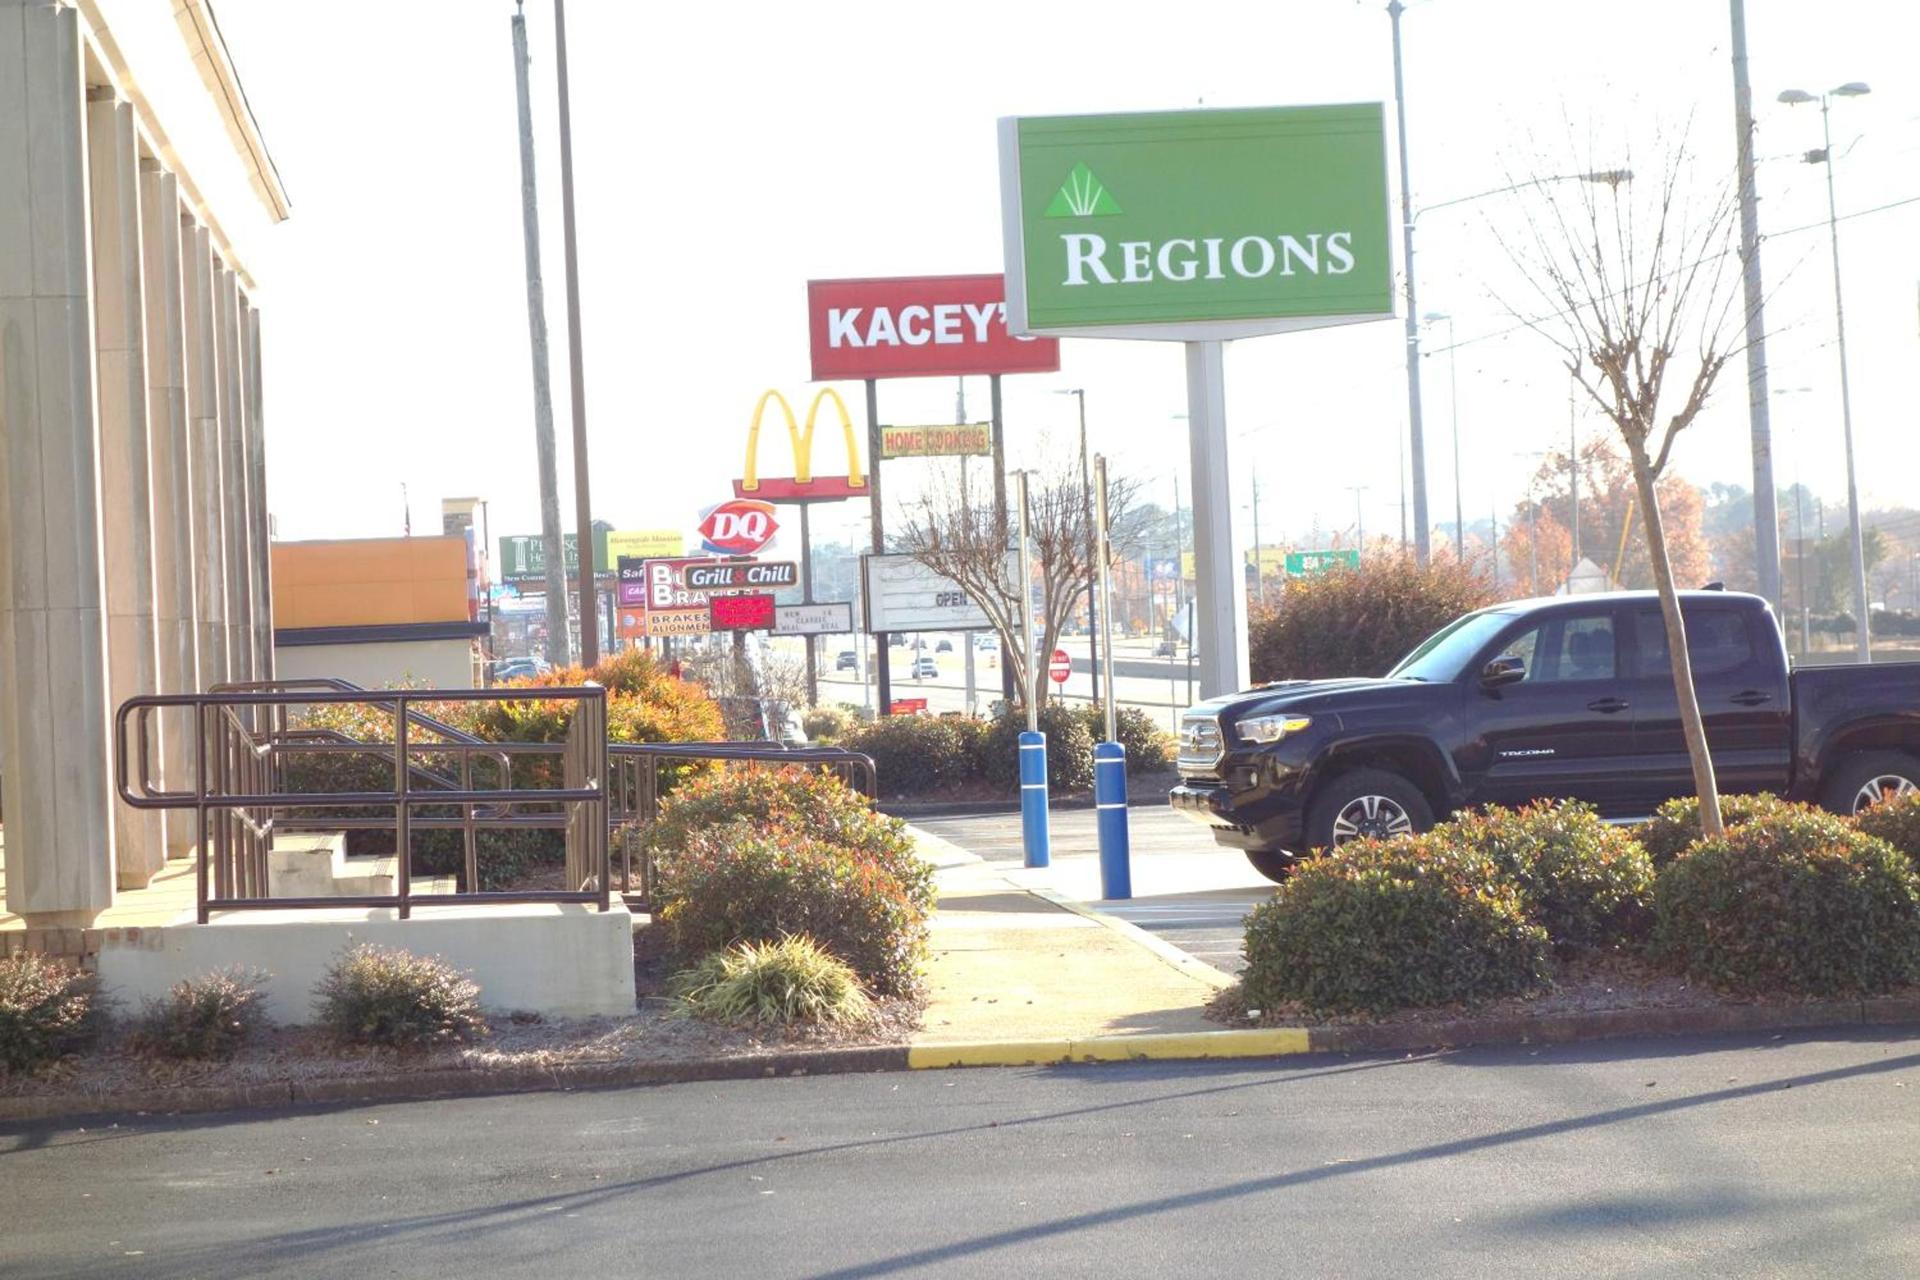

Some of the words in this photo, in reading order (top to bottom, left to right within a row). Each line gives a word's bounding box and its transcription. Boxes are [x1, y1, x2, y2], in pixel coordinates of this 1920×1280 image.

[828, 302, 1037, 348] KACEY'
[885, 431, 922, 451] HOME
[928, 427, 986, 450] COOKING
[711, 511, 767, 542] DQ
[691, 568, 732, 585] Grill
[747, 565, 790, 582] Chill
[936, 592, 968, 607] OPEN
[652, 612, 710, 624] BRAKES
[652, 623, 710, 633] ALIGNMEN
